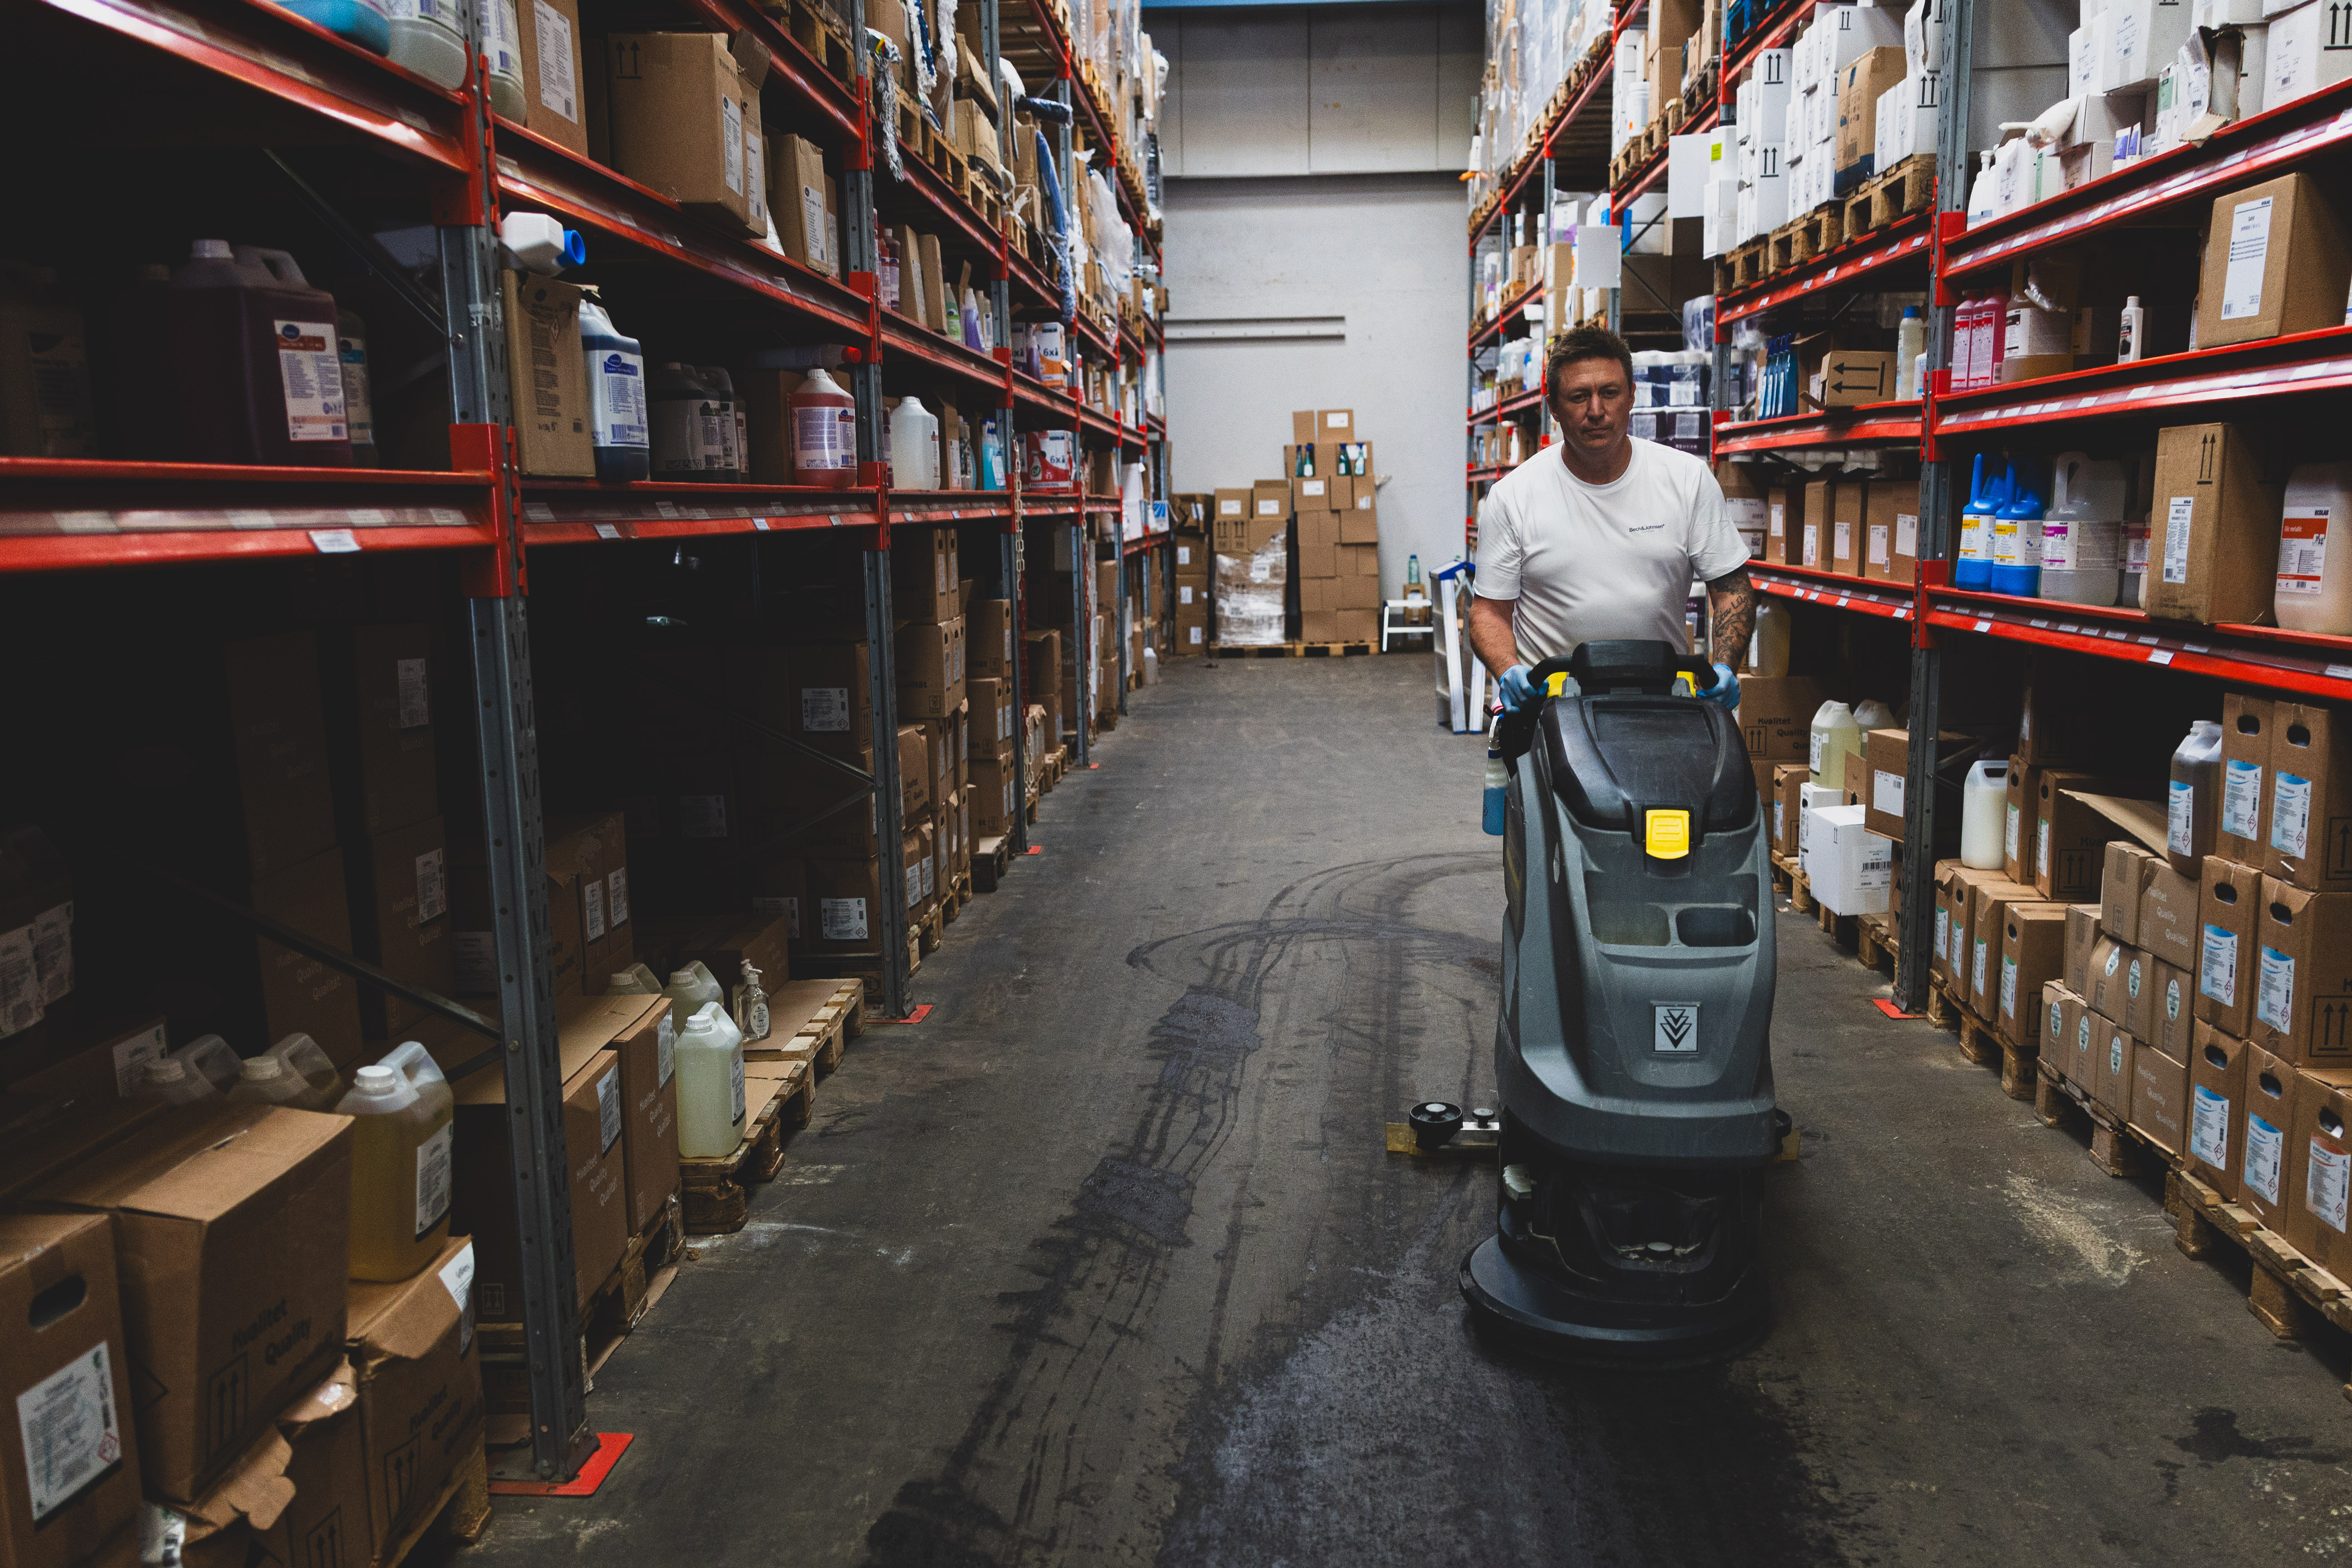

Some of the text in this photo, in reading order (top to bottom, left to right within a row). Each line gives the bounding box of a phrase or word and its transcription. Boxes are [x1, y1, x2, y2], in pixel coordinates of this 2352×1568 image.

[1758, 717, 1792, 725] Kvalitet
[1776, 728, 1808, 738] Quality
[2156, 906, 2177, 925] Quality
